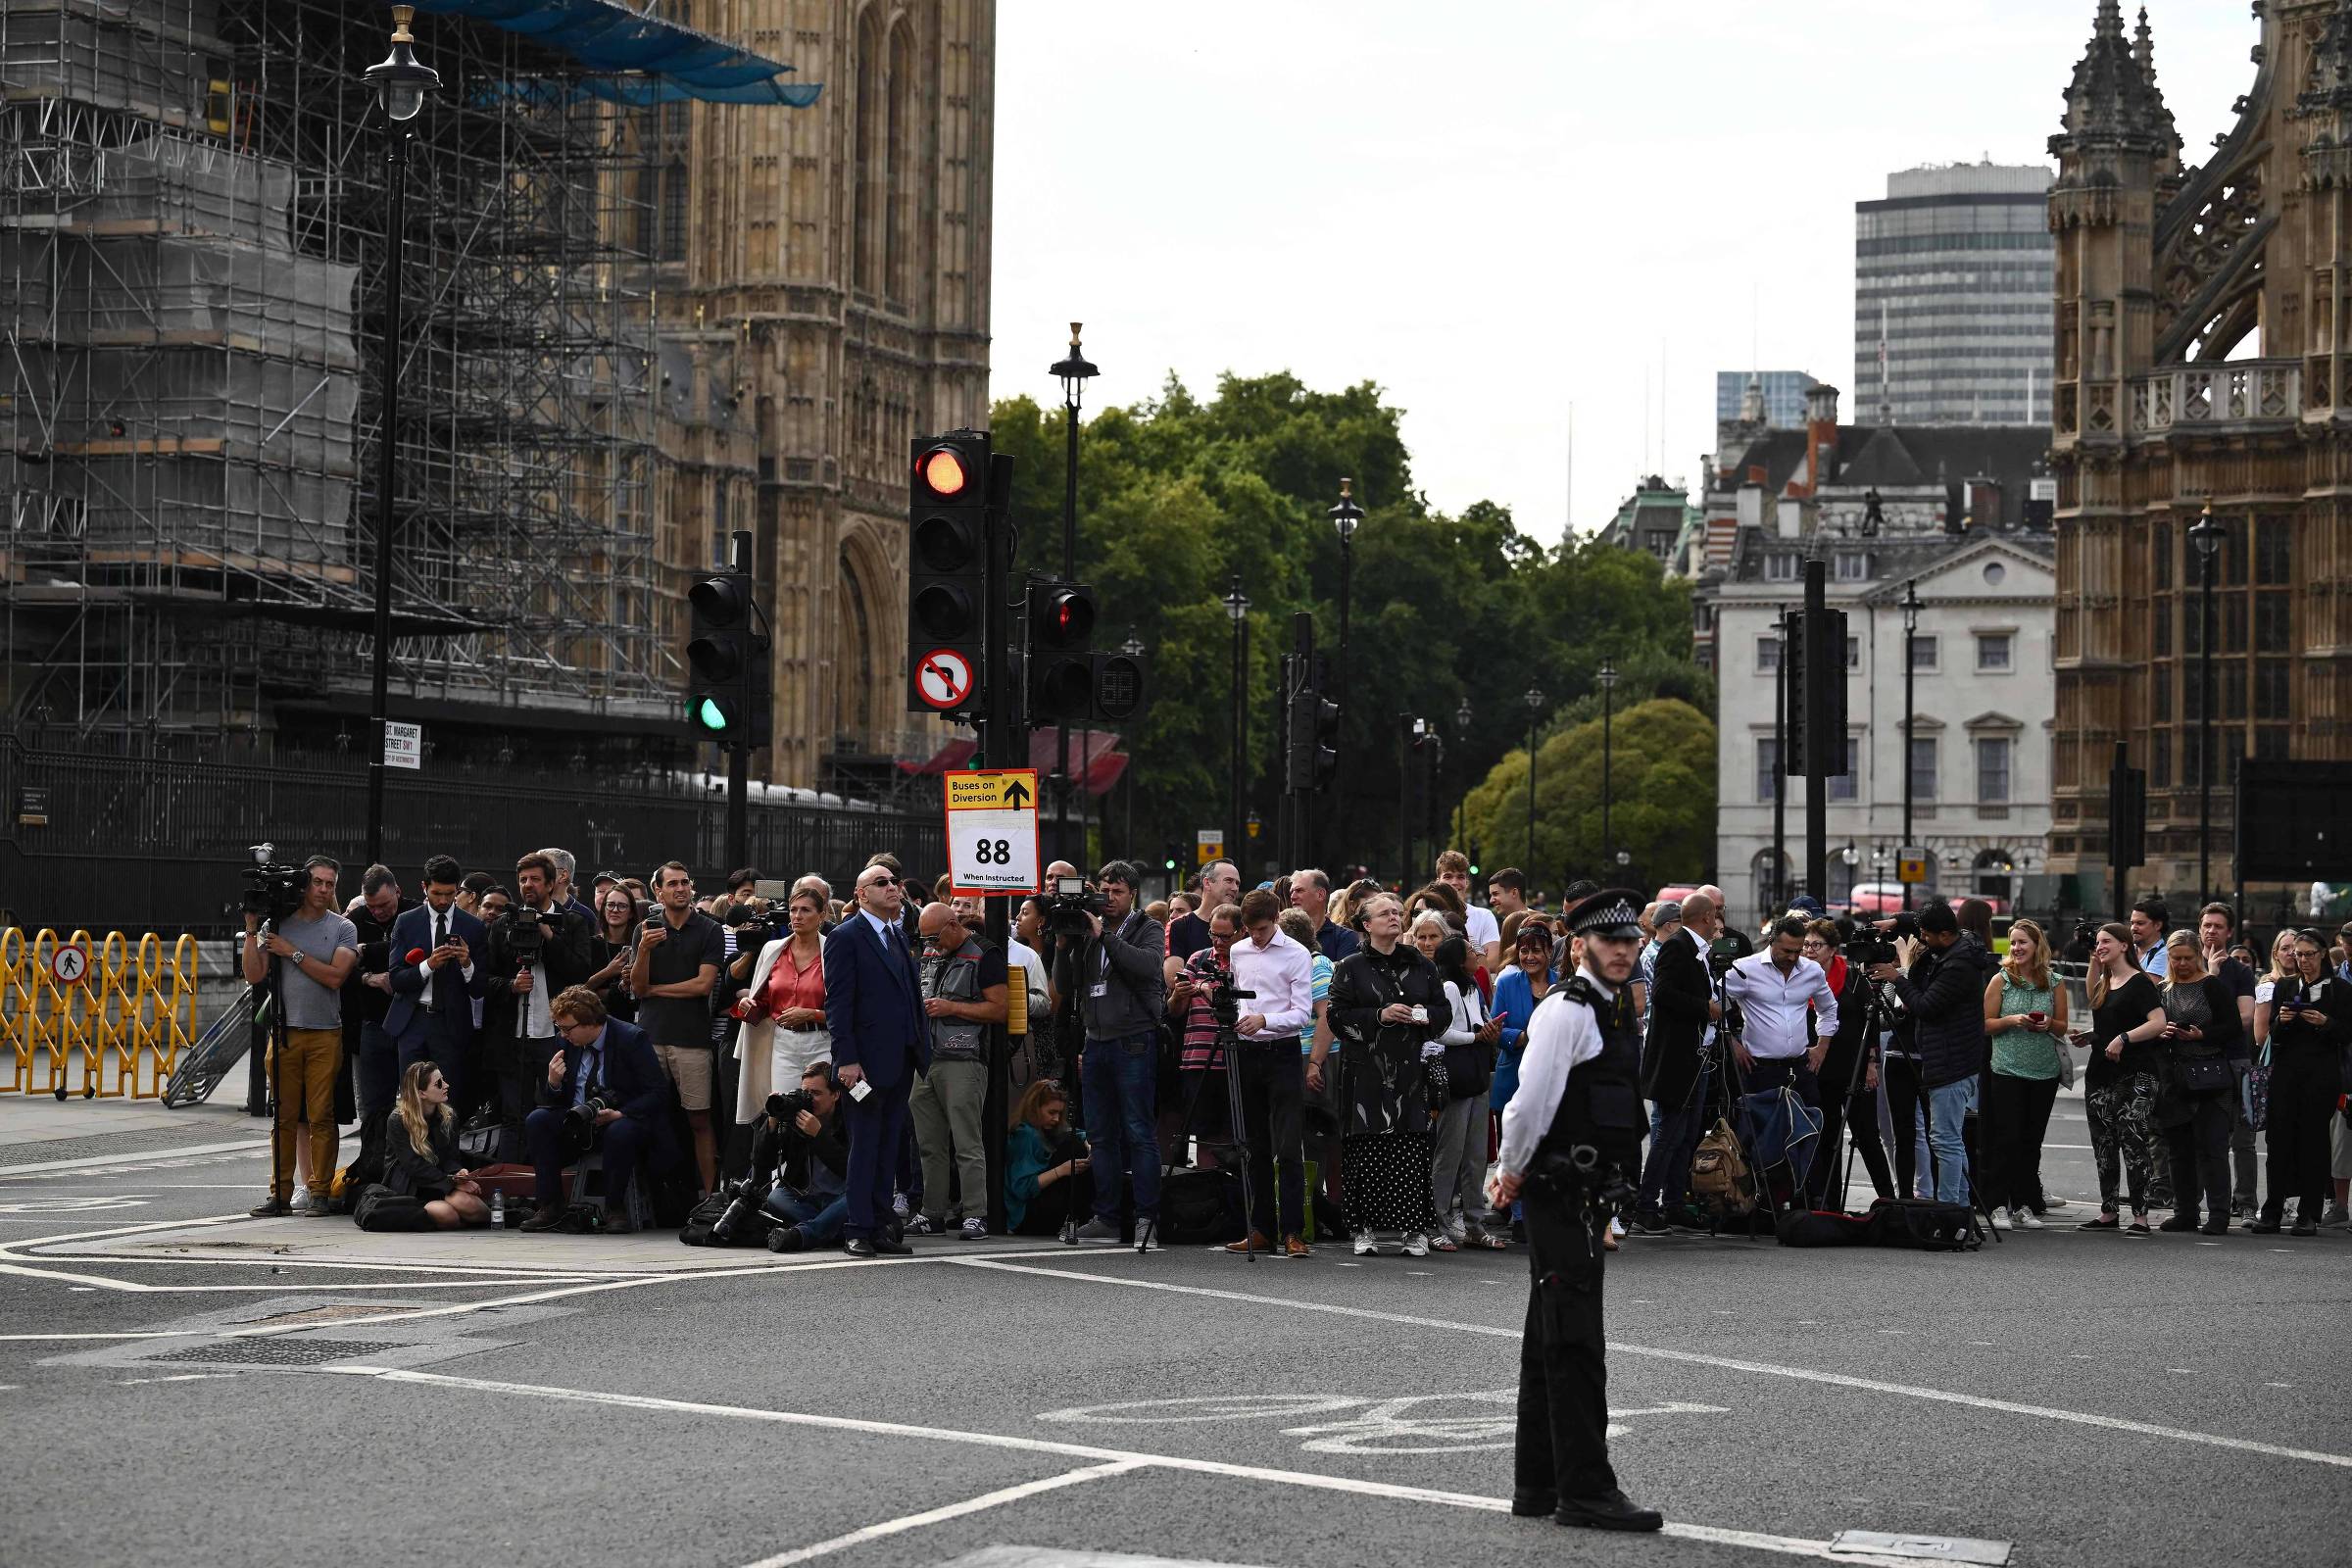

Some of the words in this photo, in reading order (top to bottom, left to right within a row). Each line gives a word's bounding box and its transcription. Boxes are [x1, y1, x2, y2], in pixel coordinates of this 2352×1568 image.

[394, 725, 417, 739] MARGARET
[385, 738, 402, 750] STREET
[953, 794, 997, 803] Diversion
[976, 839, 1010, 864] 88
